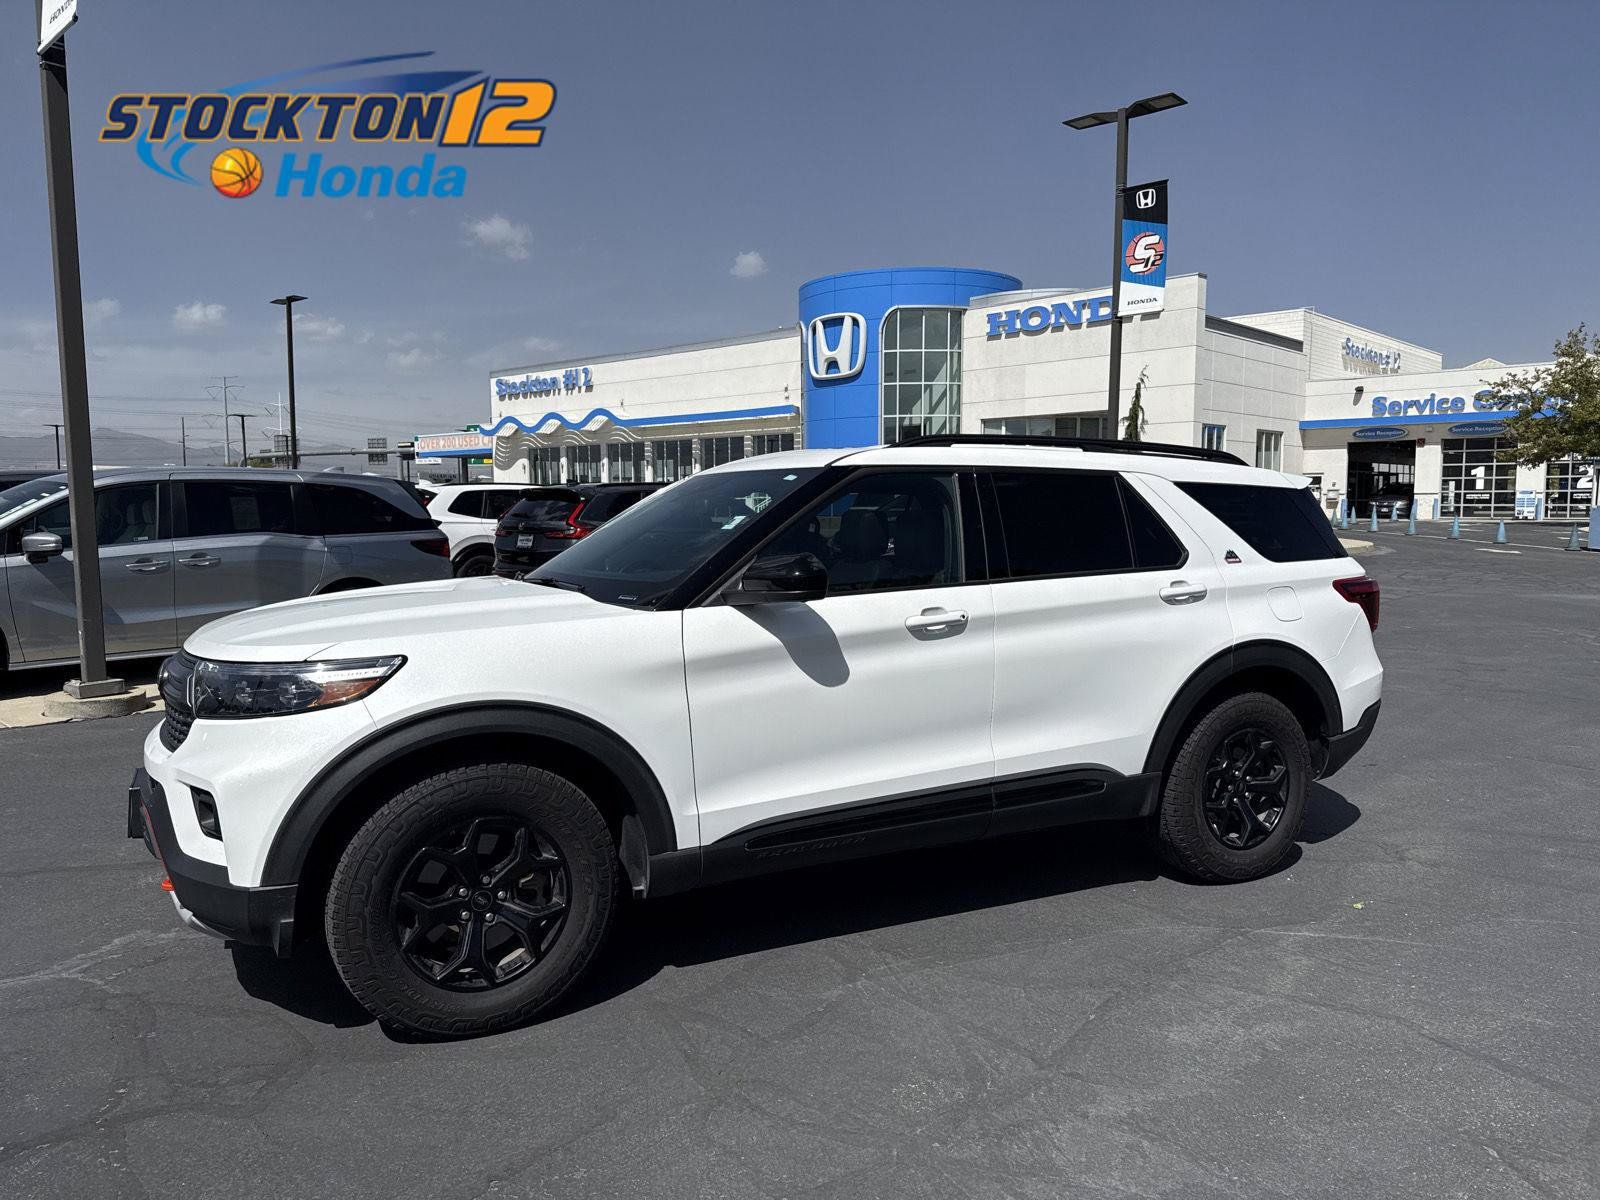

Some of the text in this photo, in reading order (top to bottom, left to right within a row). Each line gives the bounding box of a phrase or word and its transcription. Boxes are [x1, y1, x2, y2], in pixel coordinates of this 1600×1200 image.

[49, 0, 74, 23] HOND
[1127, 297, 1158, 306] HONDA
[986, 295, 1113, 336] HOND
[496, 367, 592, 395] Stockton #12
[1371, 392, 1466, 416] Service
[1376, 429, 1404, 437] Reception
[1474, 424, 1505, 432] Reception
[419, 436, 441, 450] OVER
[441, 436, 455, 448] 200
[457, 434, 480, 447] USED
[1470, 466, 1485, 490] 1
